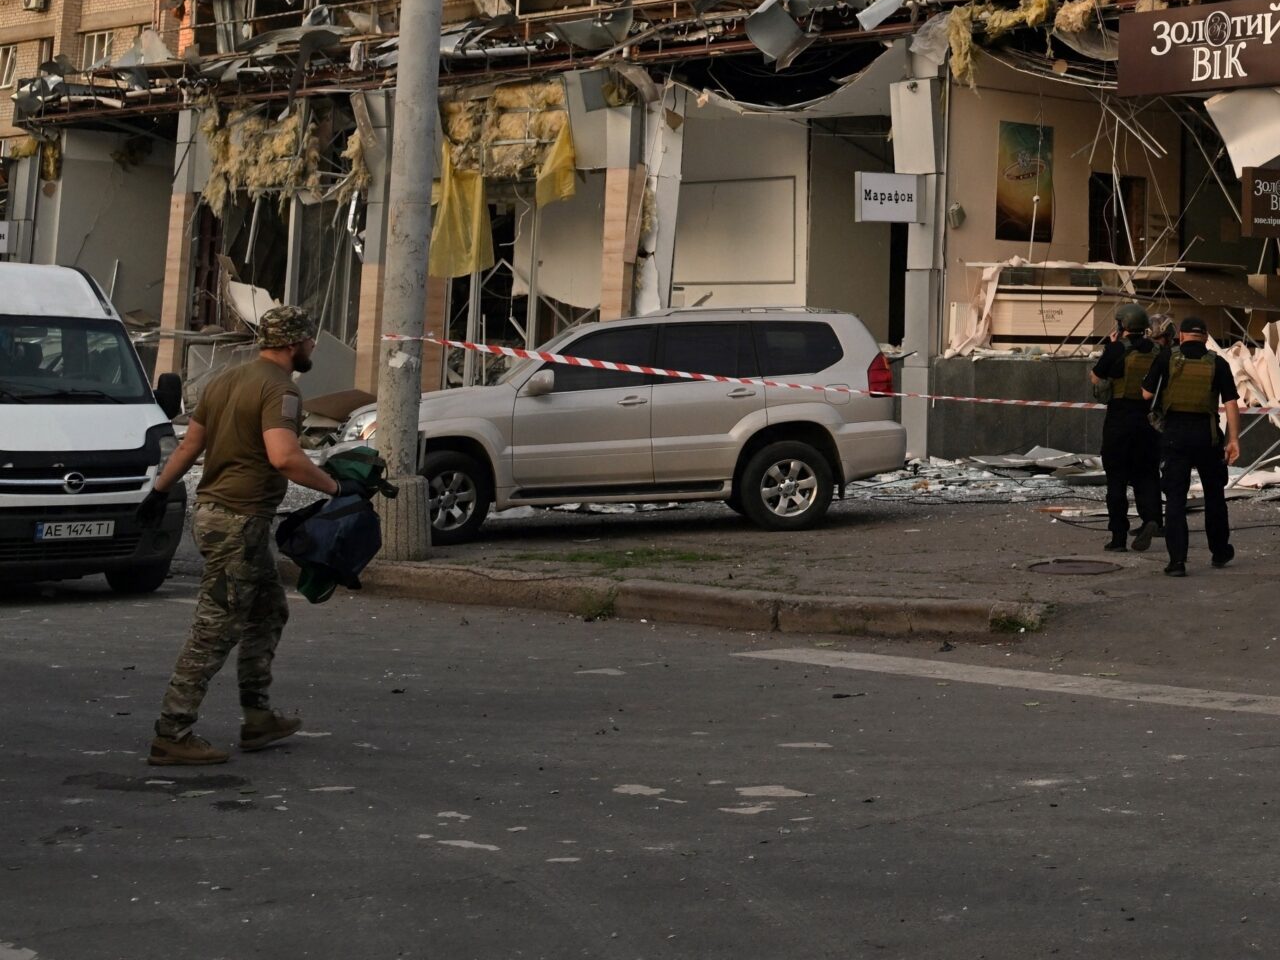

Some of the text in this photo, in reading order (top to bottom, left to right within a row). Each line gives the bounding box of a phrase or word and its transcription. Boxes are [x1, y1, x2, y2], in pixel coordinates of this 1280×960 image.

[1191, 41, 1248, 82] ВІК
[864, 189, 913, 205] Марафон
[44, 524, 63, 537] AE
[66, 523, 92, 536] 1474
[95, 522, 110, 535] TI
